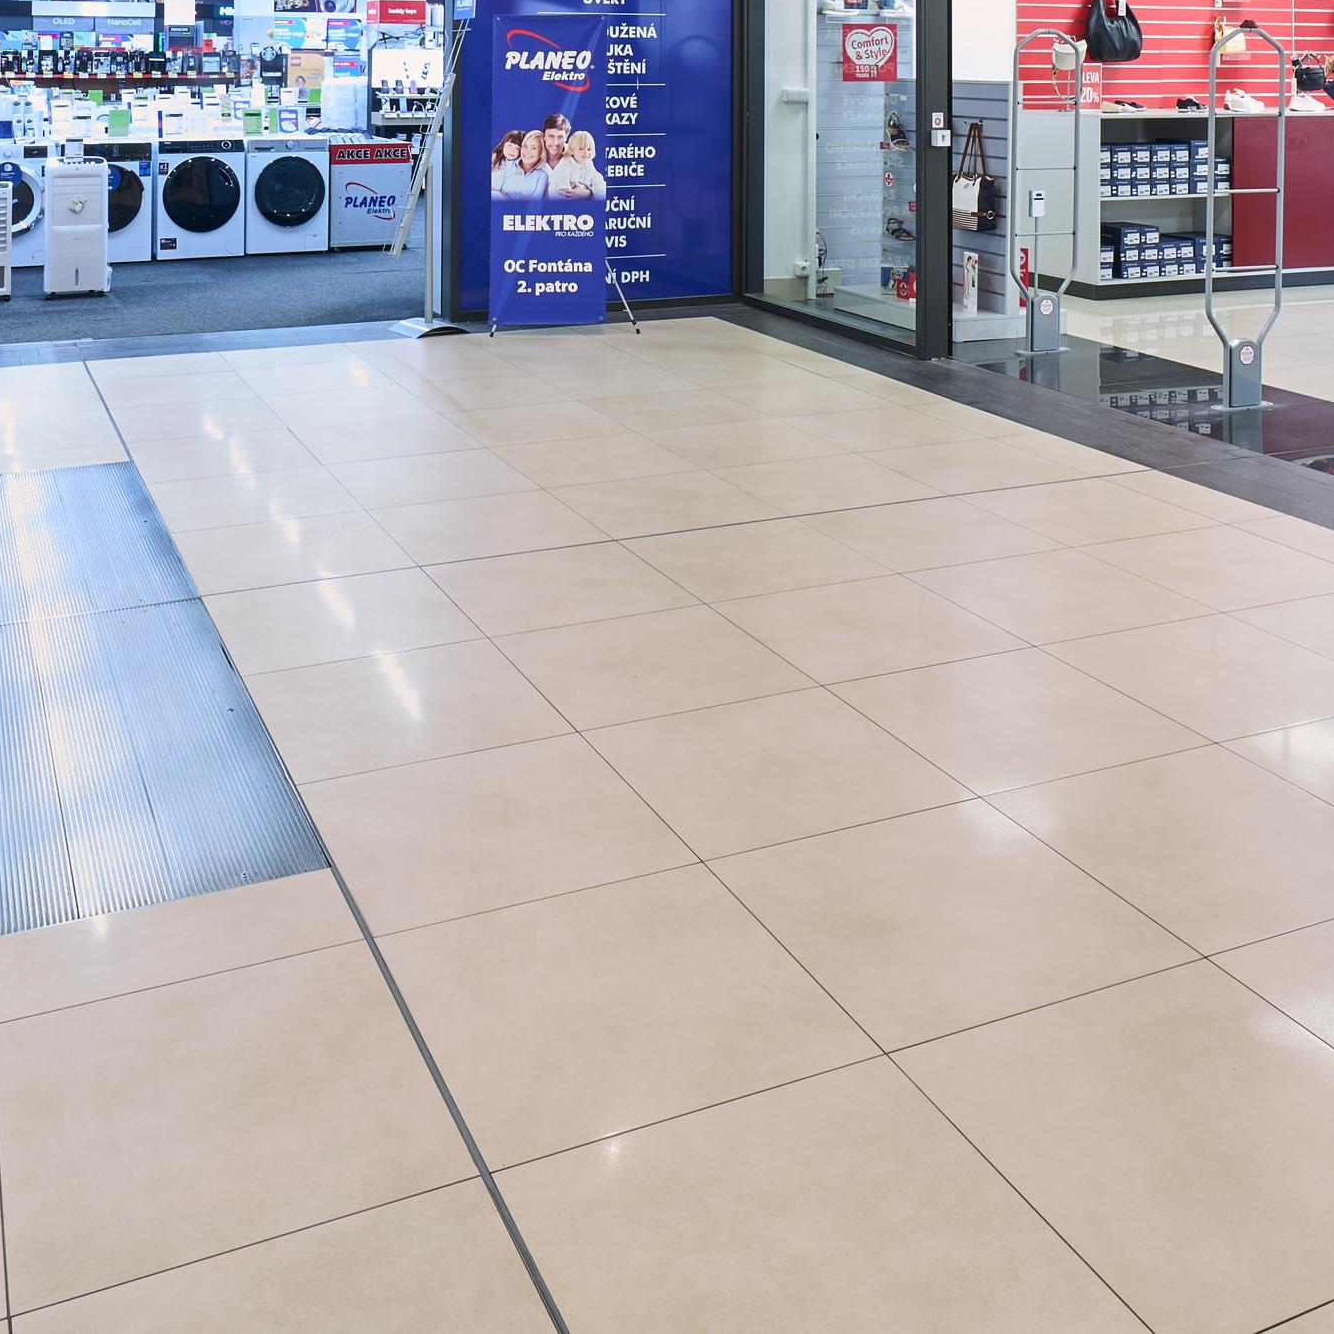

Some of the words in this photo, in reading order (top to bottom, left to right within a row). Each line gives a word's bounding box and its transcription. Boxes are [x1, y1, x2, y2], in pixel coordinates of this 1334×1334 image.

[53, 17, 76, 25] OLED
[107, 17, 141, 26] NanoCell
[606, 23, 657, 39] UŽENÁ
[851, 35, 888, 50] Comfort
[505, 50, 591, 70] PLANEO
[855, 51, 863, 60] &
[865, 48, 887, 60] Style
[855, 65, 870, 73] 150
[542, 71, 585, 81] Elektro
[335, 148, 370, 159] AKCE
[374, 147, 407, 159] AKCE
[502, 214, 594, 231] ELEKTRO
[504, 260, 525, 273] OC
[528, 259, 593, 273] Fontána
[621, 270, 649, 283] DPH
[517, 280, 532, 293] 2.
[535, 280, 578, 296] patro
